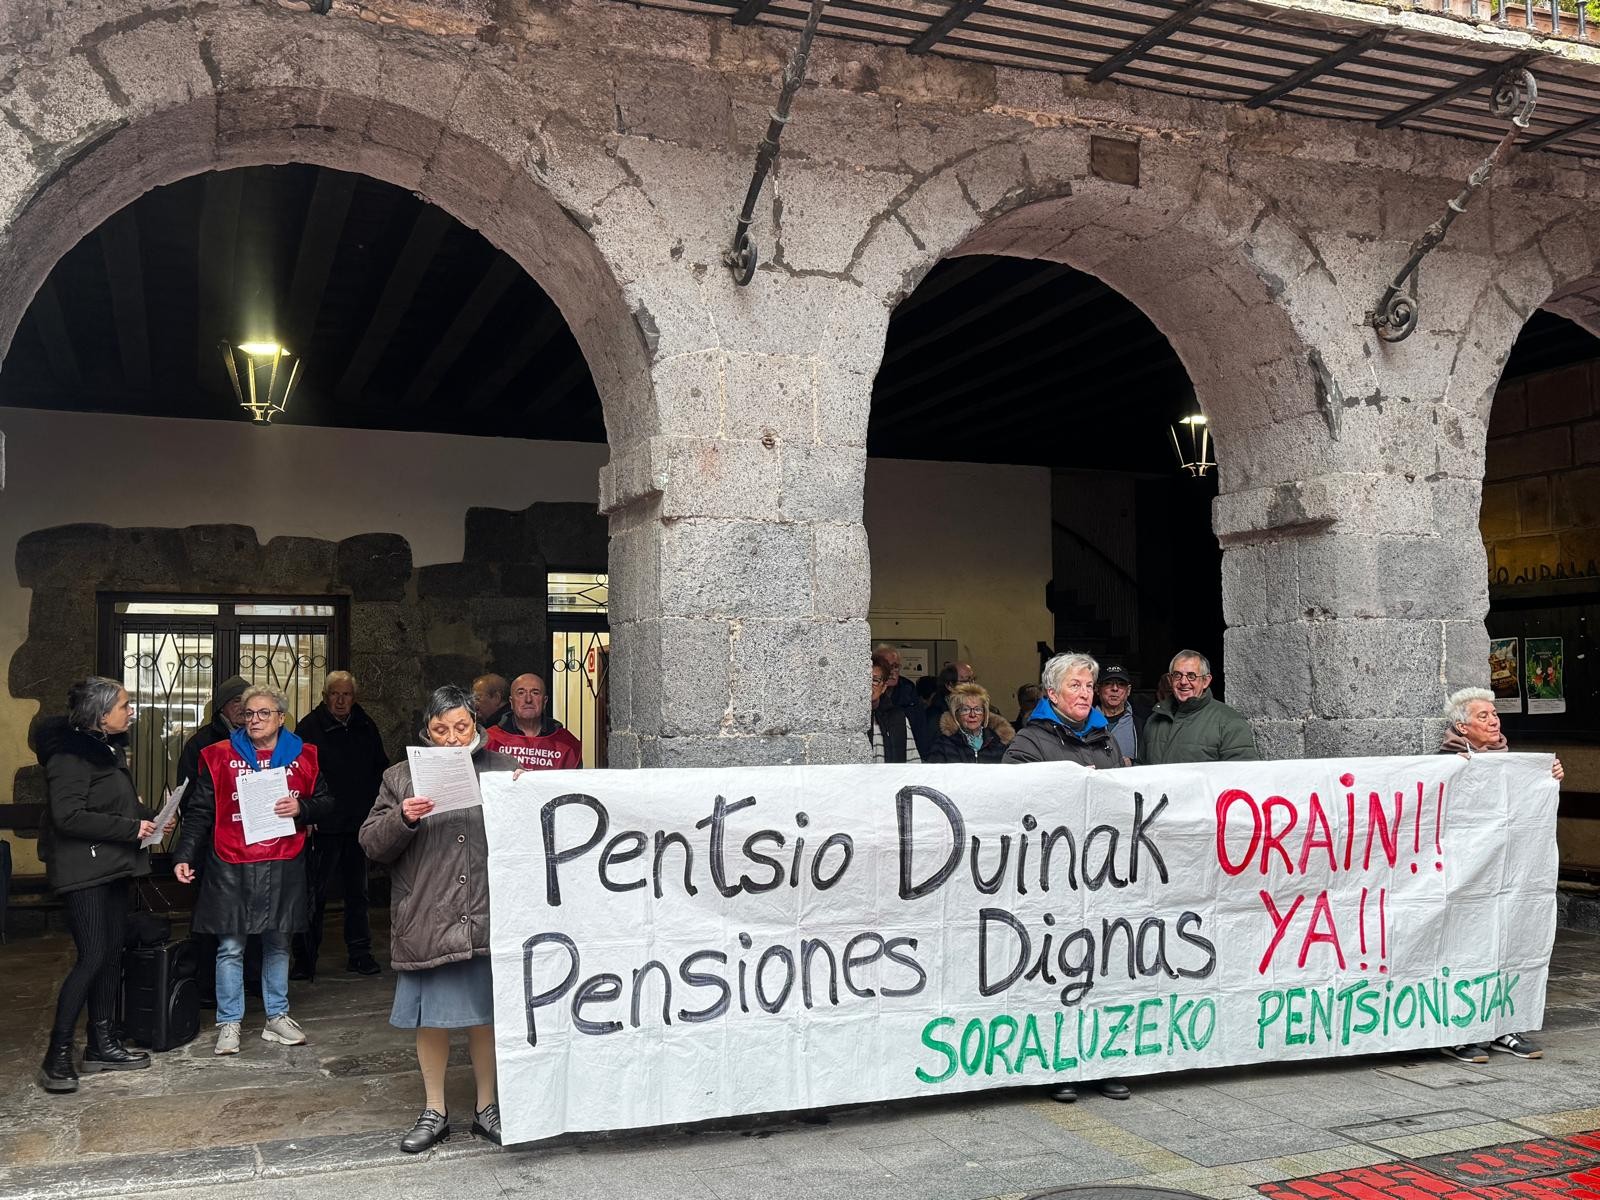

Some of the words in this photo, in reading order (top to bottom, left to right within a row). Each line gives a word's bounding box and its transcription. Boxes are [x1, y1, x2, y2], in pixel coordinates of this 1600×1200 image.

[498, 746, 561, 759] GUTXIENEKO
[513, 755, 553, 767] NTSIOA
[541, 793, 853, 906] Pentsio
[523, 932, 927, 1047] Pensiones
[979, 907, 1217, 1006] Dignas
[1258, 887, 1387, 975] YA!!
[915, 993, 1216, 1084] SORALUZEKO
